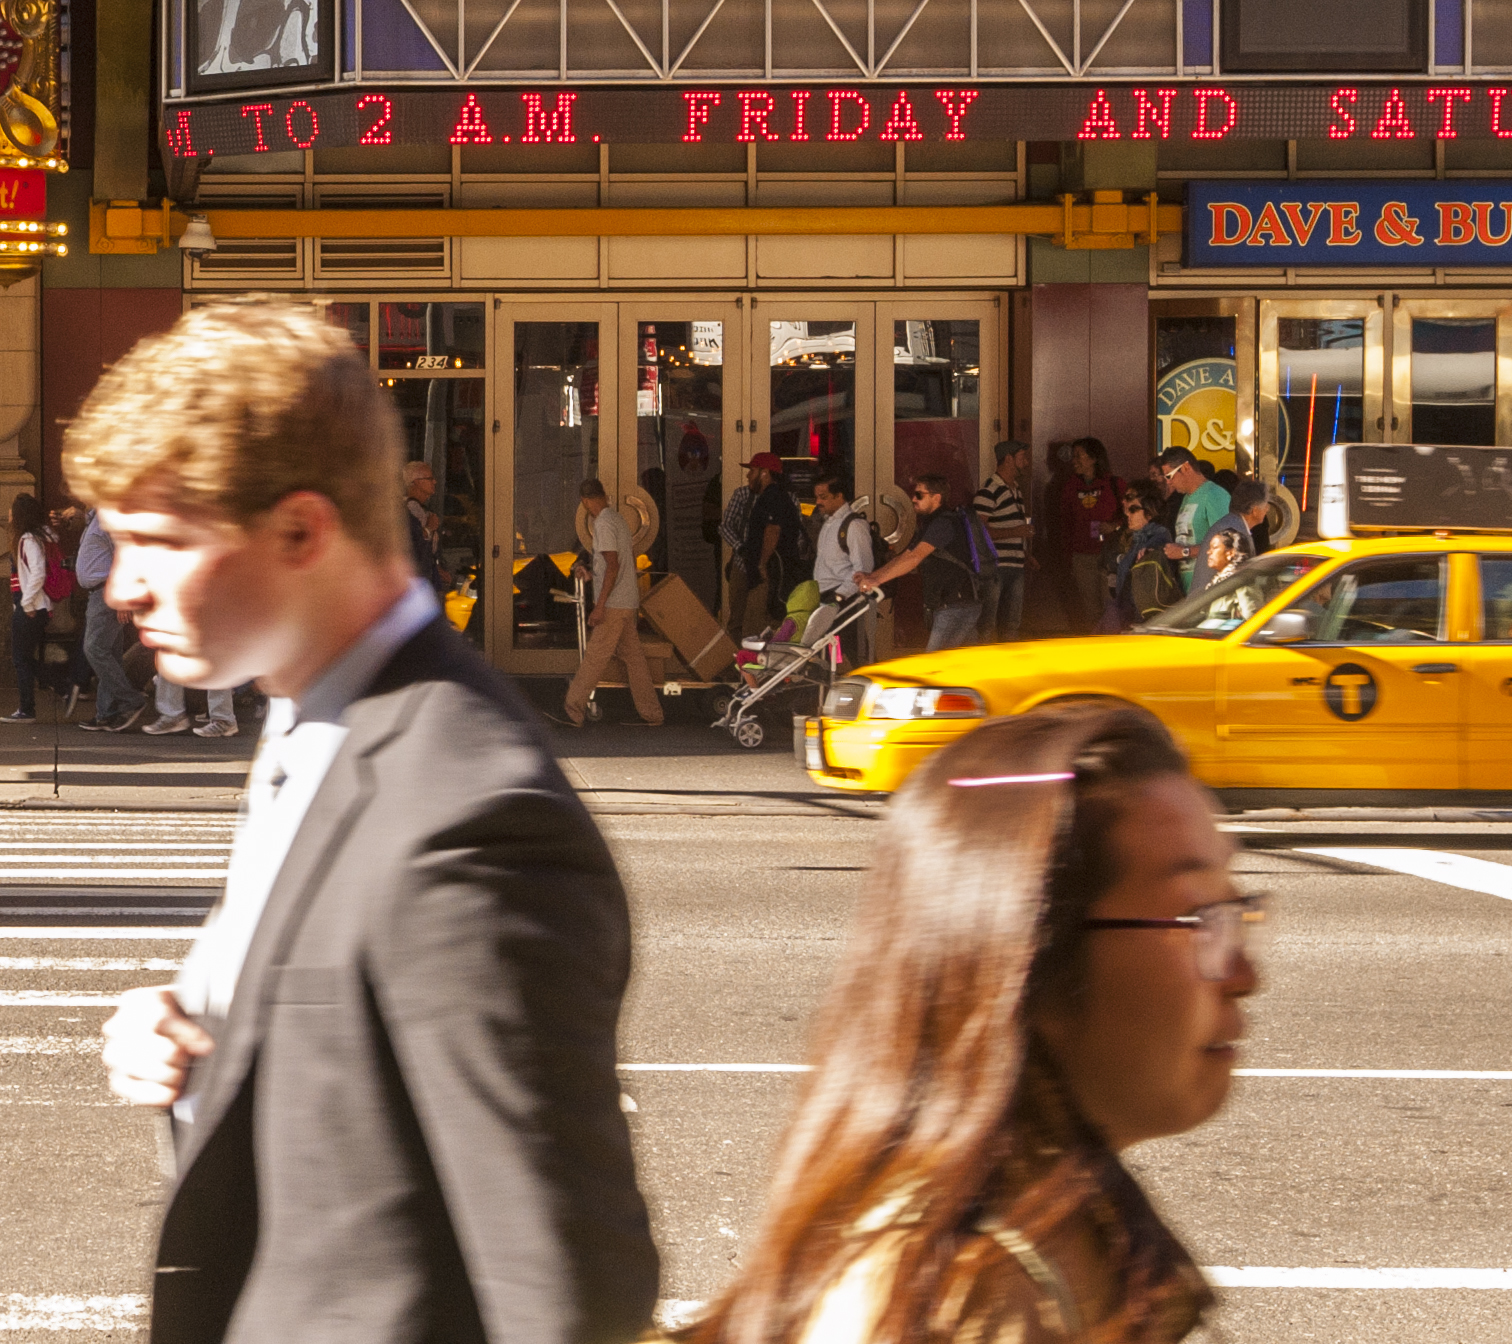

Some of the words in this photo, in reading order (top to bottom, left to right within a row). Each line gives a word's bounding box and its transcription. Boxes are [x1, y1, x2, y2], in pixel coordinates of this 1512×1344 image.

[241, 100, 320, 152] TO
[356, 92, 393, 146] 2
[450, 92, 606, 146] A.M.
[681, 90, 980, 144] FRIDAY
[1076, 88, 1240, 141] AND
[1209, 197, 1364, 250] DAVE
[1372, 201, 1427, 248] &
[416, 356, 447, 370] 234
